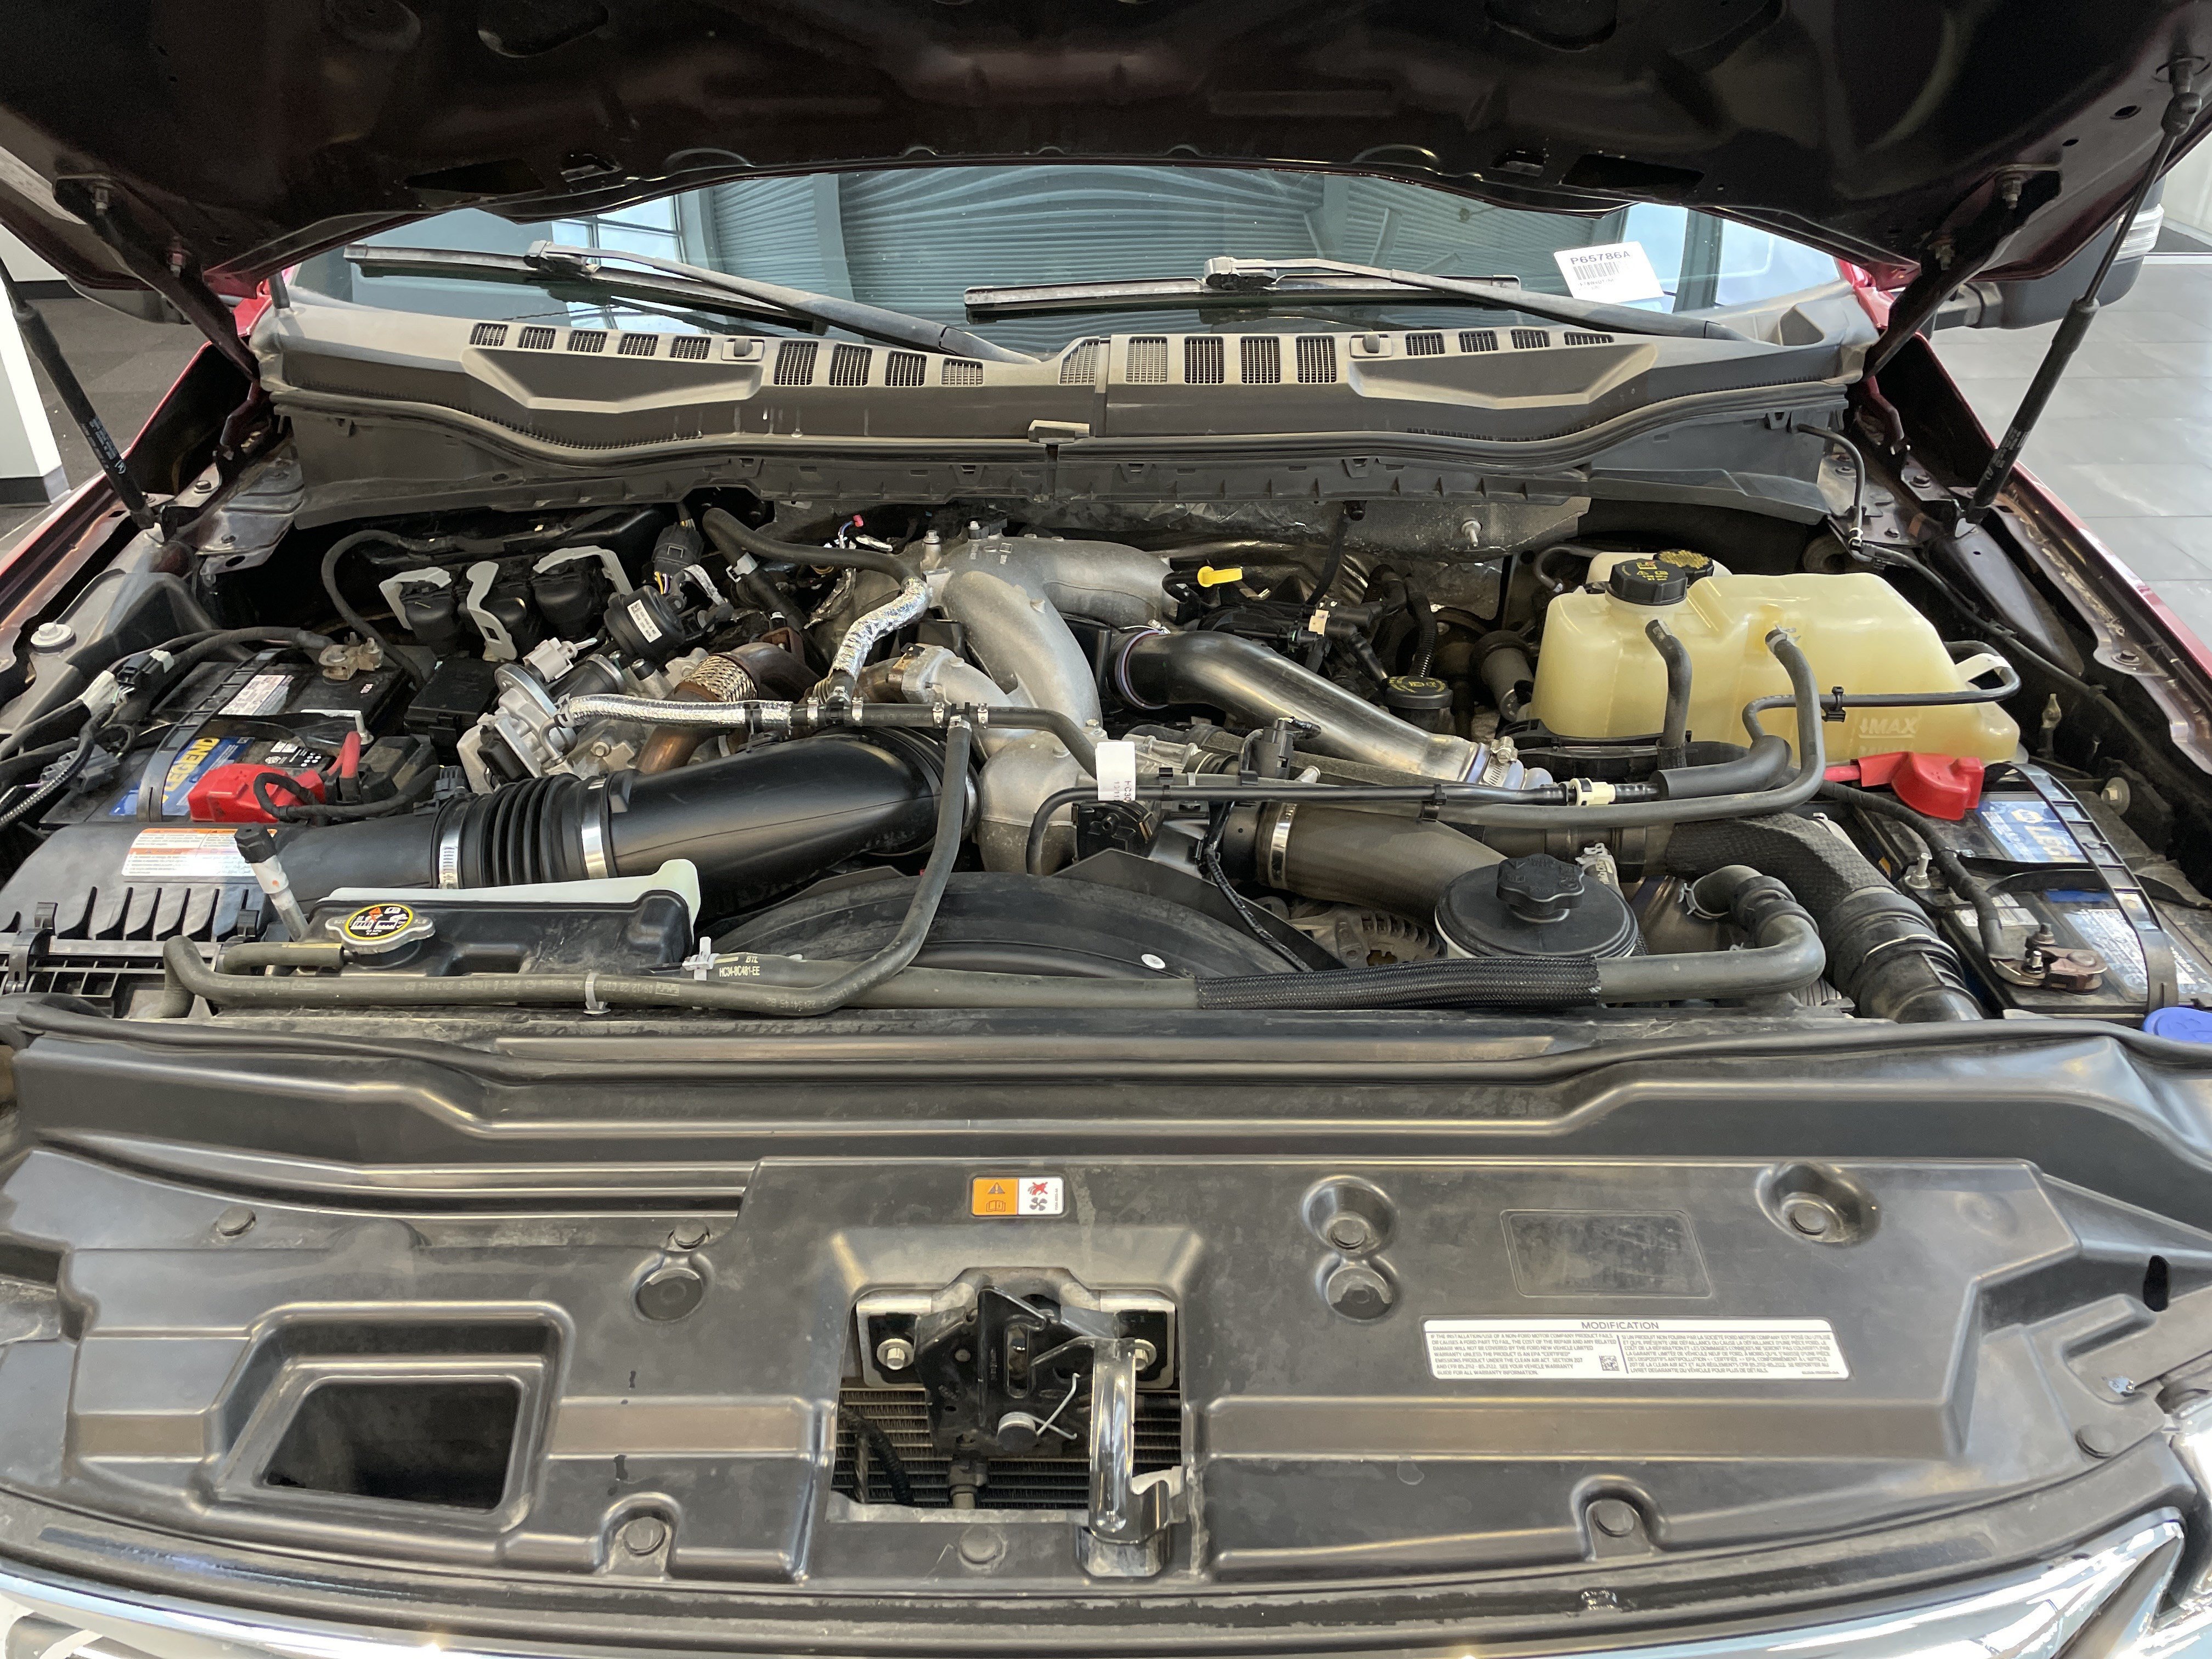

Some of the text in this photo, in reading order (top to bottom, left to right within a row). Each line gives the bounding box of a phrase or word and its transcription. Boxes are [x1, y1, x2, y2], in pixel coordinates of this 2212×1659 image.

[1570, 251, 1630, 264] P65786A
[1869, 718, 1918, 734] MAX
[165, 737, 221, 792] LEGEND
[1581, 1321, 1660, 1330] MODIFICATION
